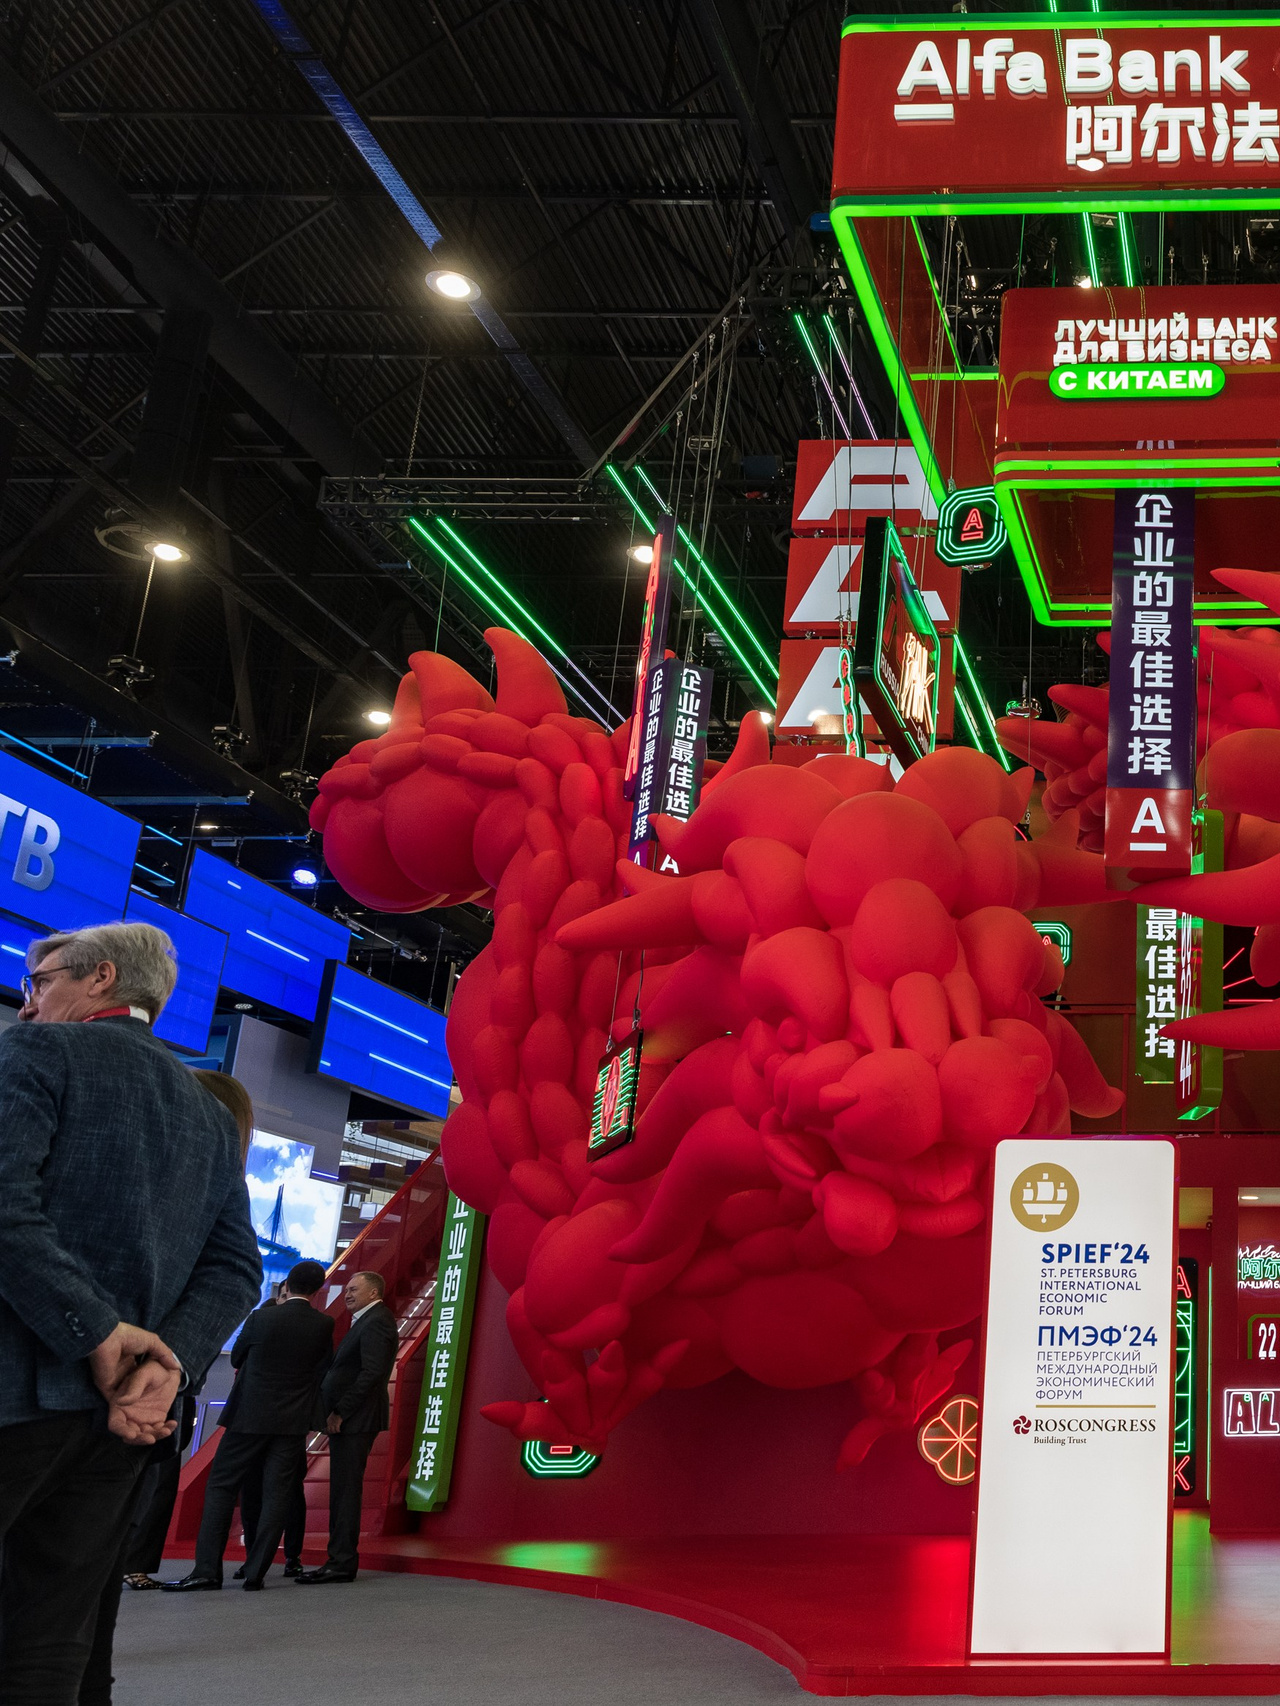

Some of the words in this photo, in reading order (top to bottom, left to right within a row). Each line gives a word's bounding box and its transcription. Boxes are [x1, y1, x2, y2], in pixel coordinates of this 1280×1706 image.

[897, 38, 1047, 97] Alfa
[1065, 36, 1250, 93] Bank
[1054, 312, 1189, 342] ЛУЧШИЙ
[1197, 317, 1277, 340] БАНК
[1053, 341, 1119, 367] ДЛЯ
[1127, 340, 1272, 363] БИЗНЕСА
[1058, 373, 1078, 390] С
[1088, 370, 1213, 390] КИТАЕМ
[1128, 493, 1174, 775] 企业的最佳选择
[666, 668, 702, 823] 企业的最佳选
[634, 668, 664, 841] 企业的最佳选择
[1041, 1242, 1149, 1264] SPIEF'24
[1041, 1268, 1057, 1278] ST.
[1060, 1268, 1137, 1278] PETERSBURG
[1040, 1281, 1141, 1291] INTERNATIONAL
[1039, 1293, 1108, 1303] ECONOMIC
[1039, 1306, 1084, 1316] FORUM
[1038, 1325, 1158, 1347] ПМЭФ'24
[1037, 1350, 1141, 1361] ПЕТЕРБУРГСКИЙ
[1036, 1362, 1158, 1375] МЕЖДУНАРОДНЫЙ
[1036, 1375, 1155, 1387] ЭКОНОМИЧЕСКИЙ
[1036, 1389, 1083, 1400] ФОРУМ
[1034, 1418, 1156, 1432] ROSCONGRESS
[1034, 1436, 1066, 1446] Building
[1067, 1436, 1087, 1444] Trust
